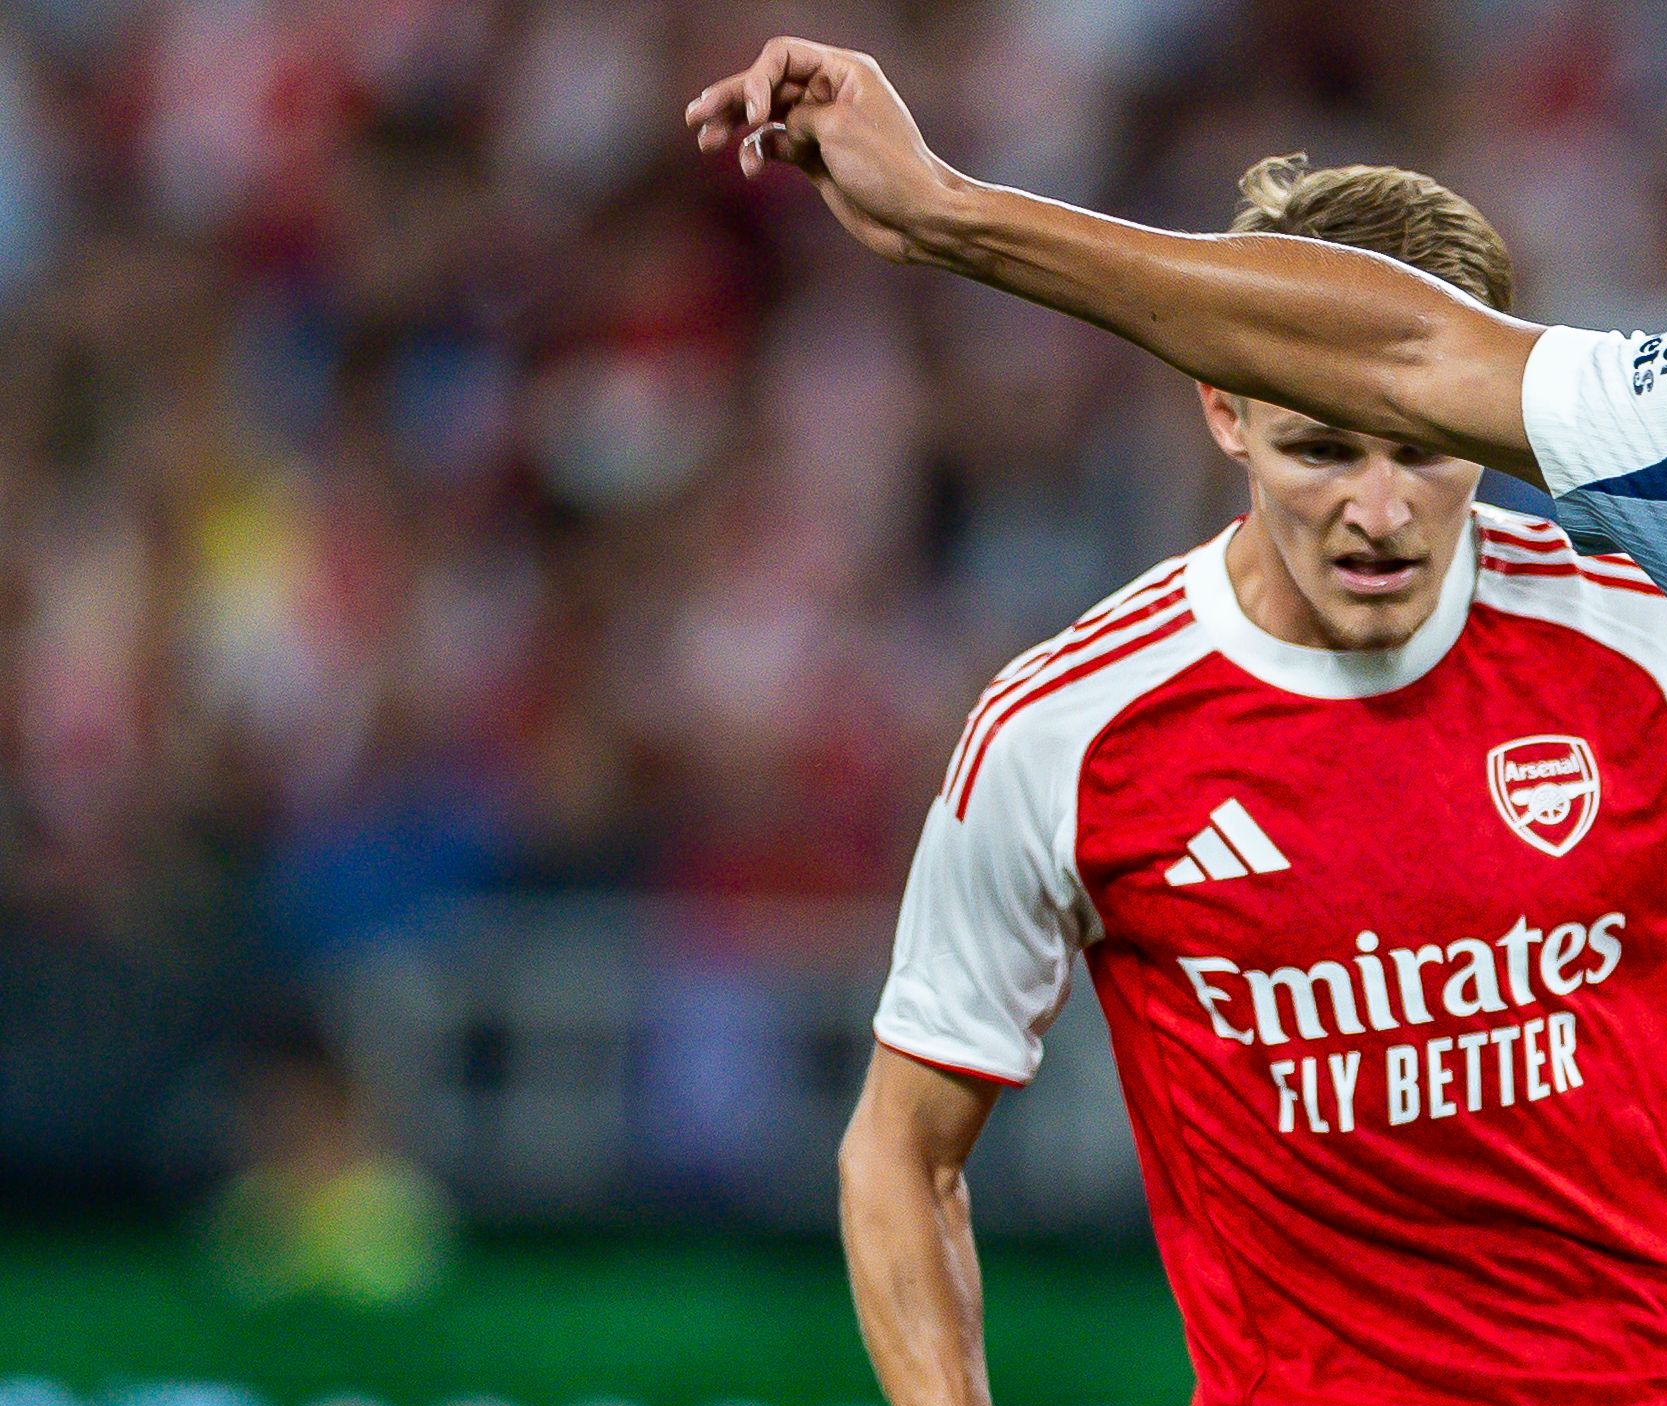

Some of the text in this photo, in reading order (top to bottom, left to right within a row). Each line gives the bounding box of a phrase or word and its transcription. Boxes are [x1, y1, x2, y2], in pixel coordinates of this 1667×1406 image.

[1504, 753, 1581, 783] Arsenal
[1176, 912, 1626, 1046] Emirates
[1270, 1011, 1584, 1133] FLY BETTER
